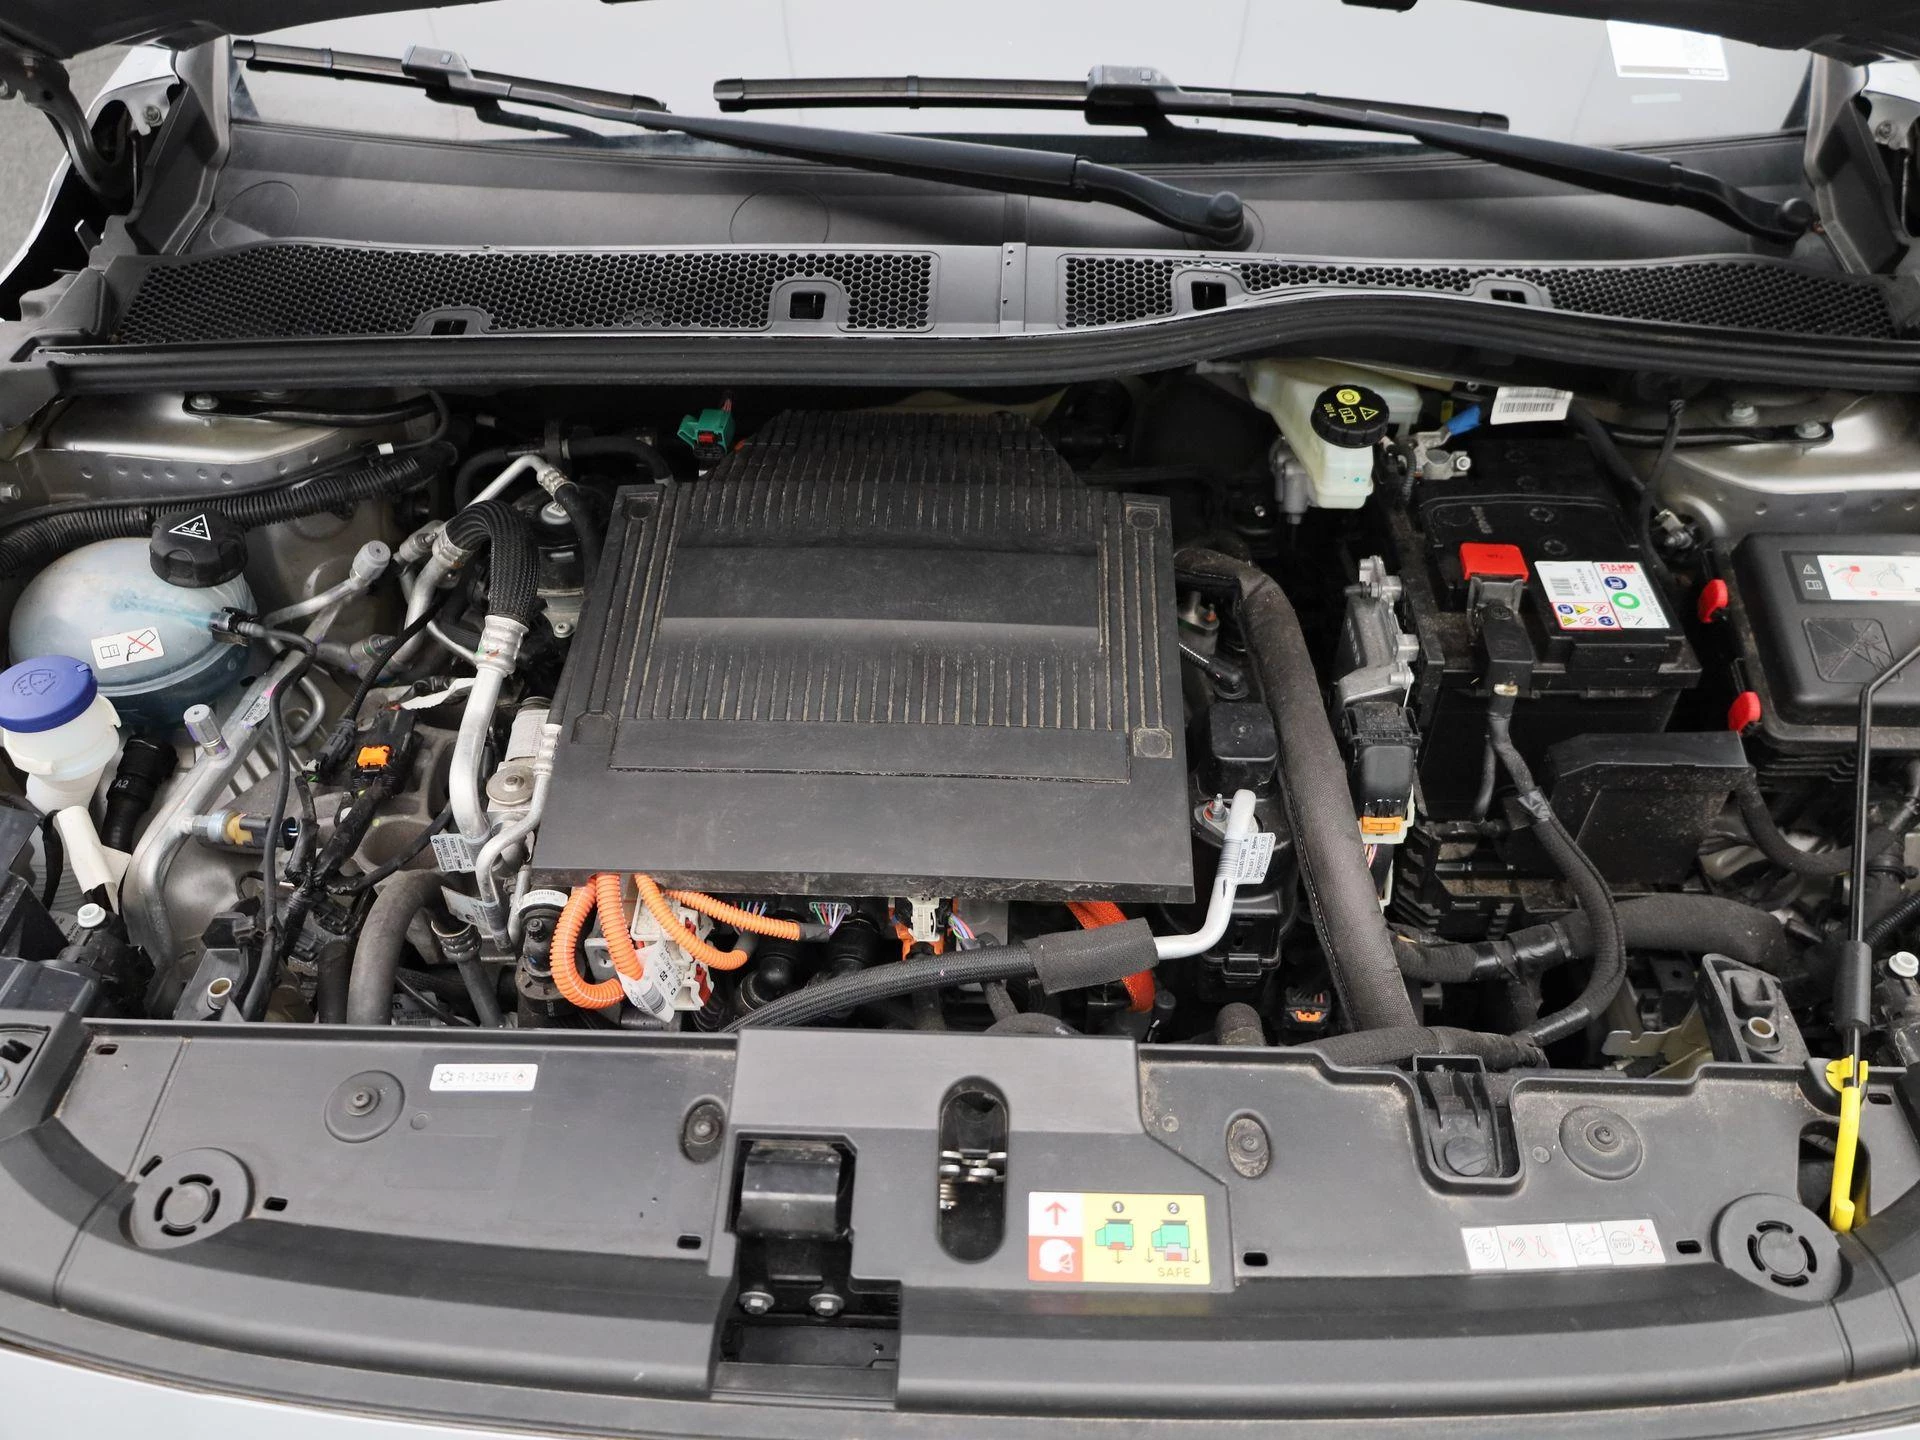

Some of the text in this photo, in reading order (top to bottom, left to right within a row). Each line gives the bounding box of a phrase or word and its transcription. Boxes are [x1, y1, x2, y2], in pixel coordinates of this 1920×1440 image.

[1600, 563, 1636, 573] FIAMM
[114, 780, 129, 788] A2
[456, 1071, 511, 1082] R-1234YF
[1157, 1267, 1191, 1278] SAFE
